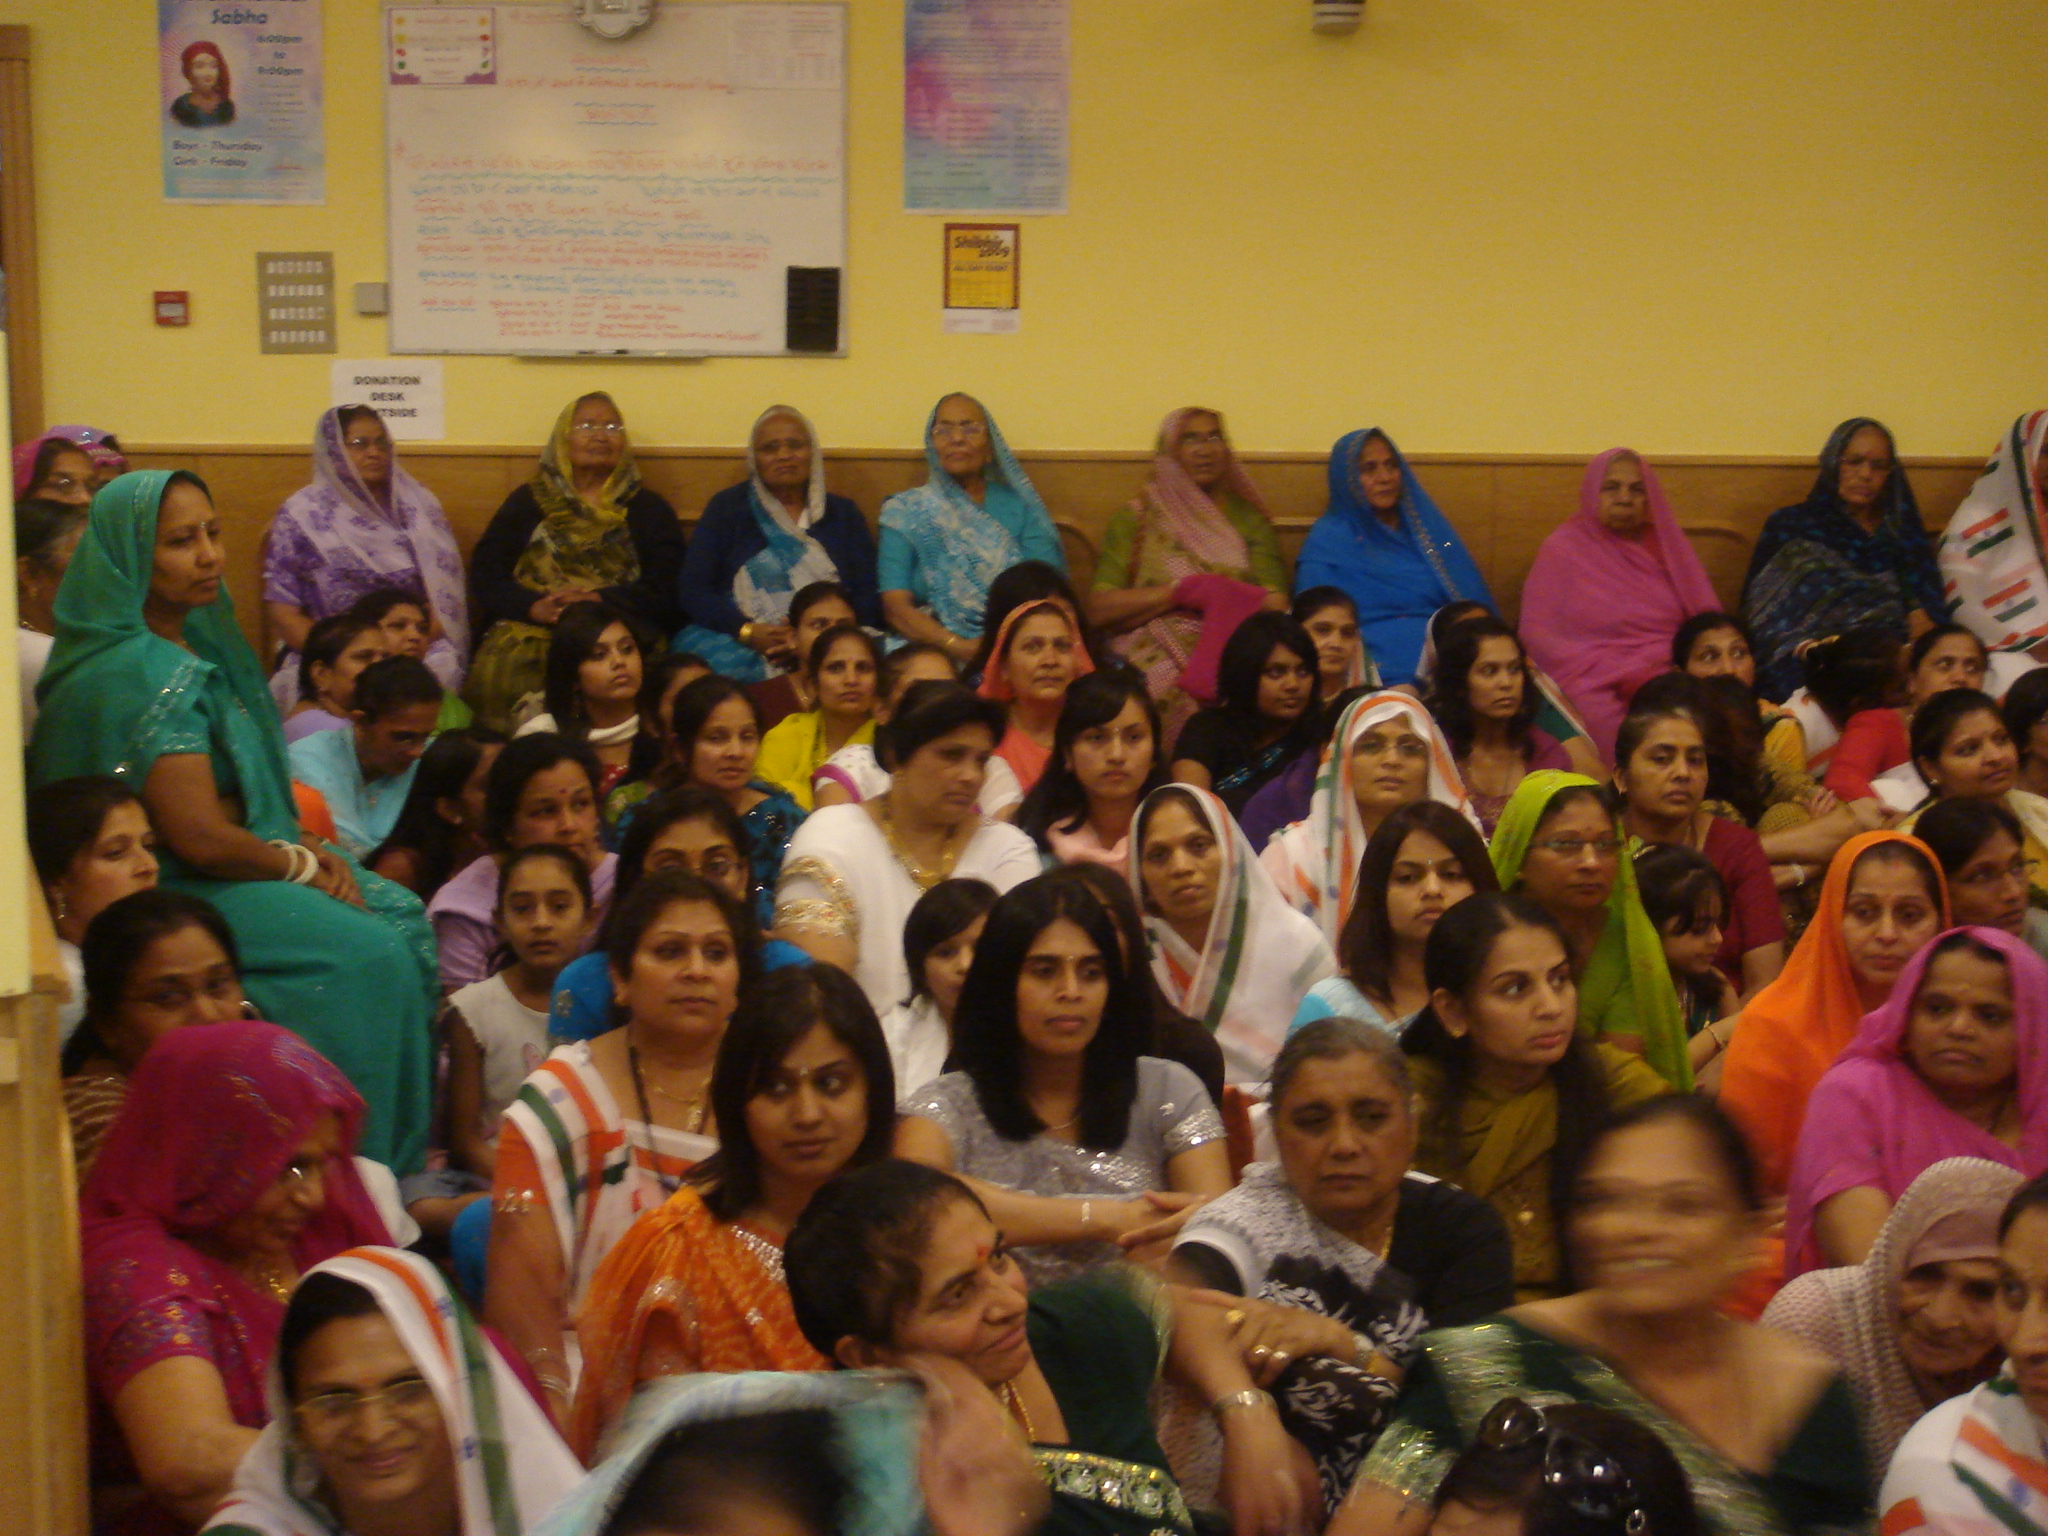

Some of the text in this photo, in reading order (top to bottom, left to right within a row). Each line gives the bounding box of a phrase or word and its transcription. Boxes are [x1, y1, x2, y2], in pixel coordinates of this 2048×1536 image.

[212, 9, 268, 24] Sabha
[212, 141, 262, 152] Thursday
[210, 156, 248, 168] Friday
[353, 376, 420, 385] DONATION
[371, 392, 405, 401] DESK
